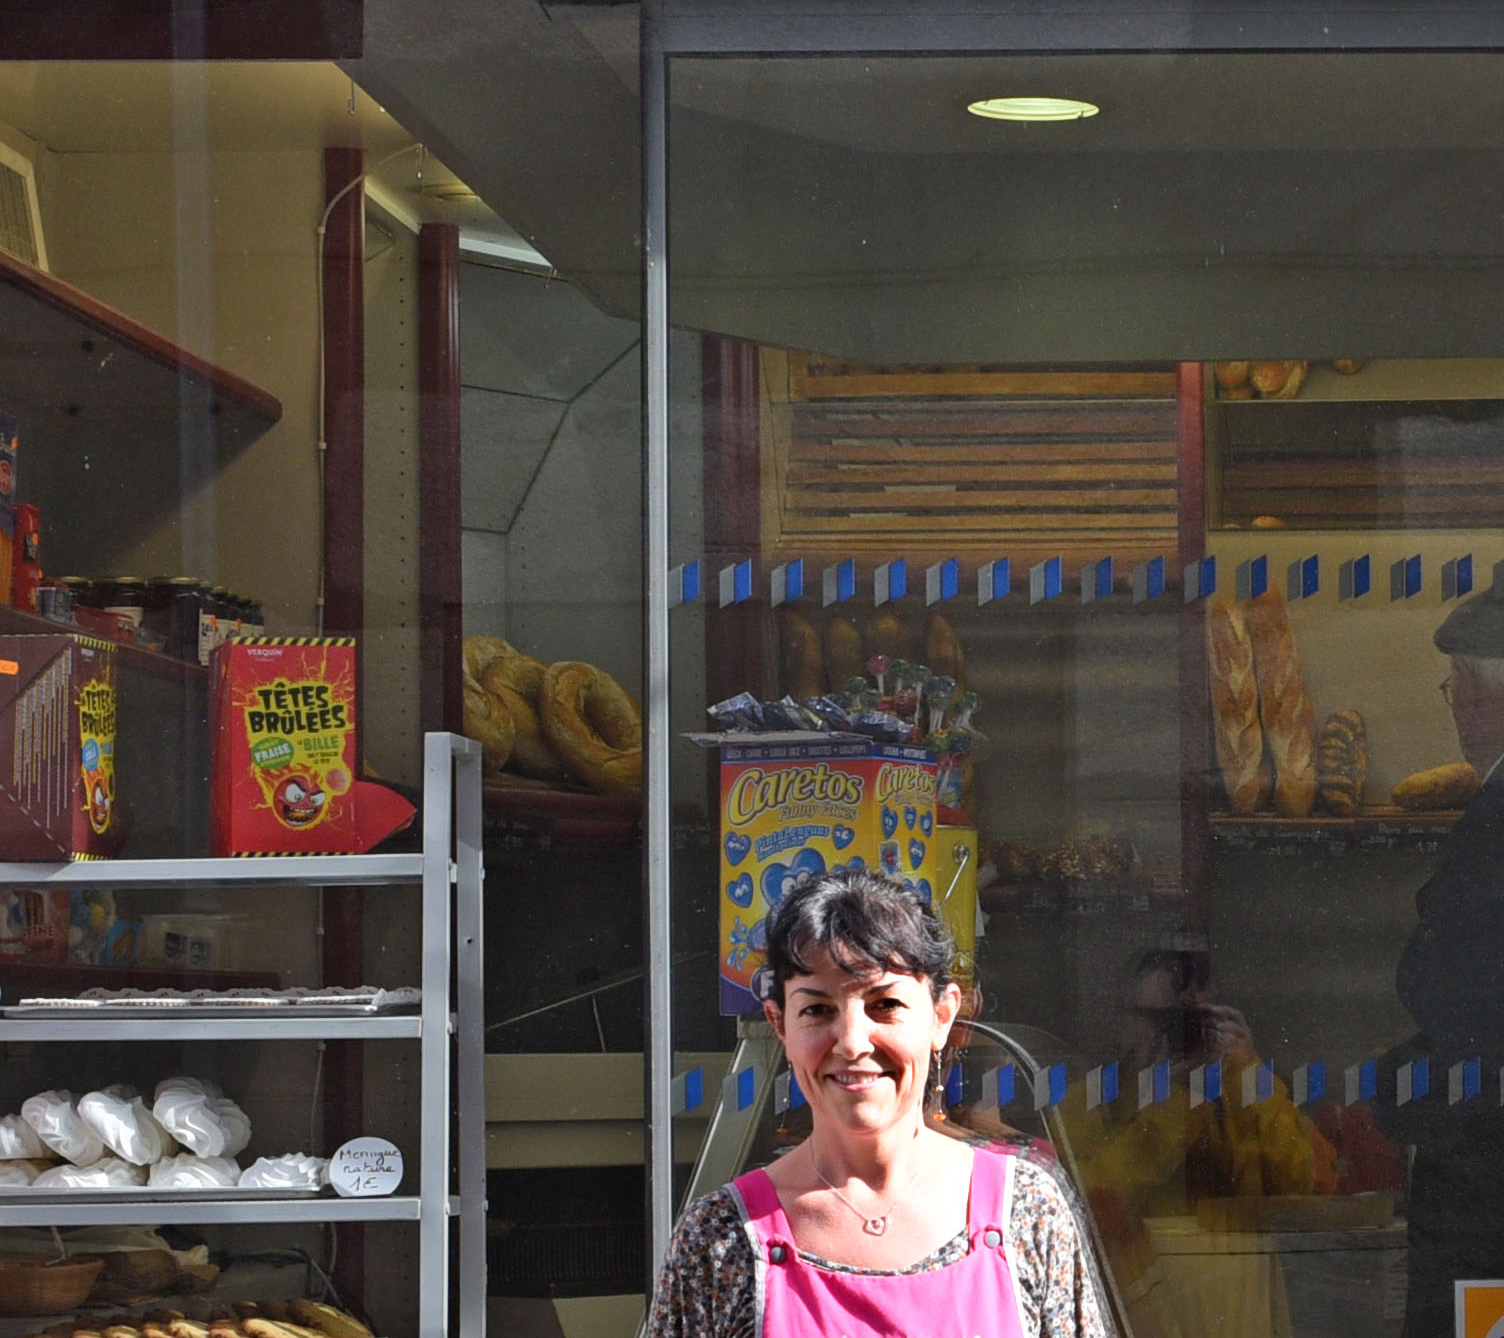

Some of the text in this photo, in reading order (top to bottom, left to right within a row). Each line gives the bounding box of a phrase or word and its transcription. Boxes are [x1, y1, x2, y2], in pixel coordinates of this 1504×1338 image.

[258, 682, 329, 711] TÊTES
[248, 705, 346, 735] BRÛLÉES
[254, 742, 292, 762] FRAISE
[728, 762, 864, 826] Caretos
[875, 763, 936, 804] Caretos
